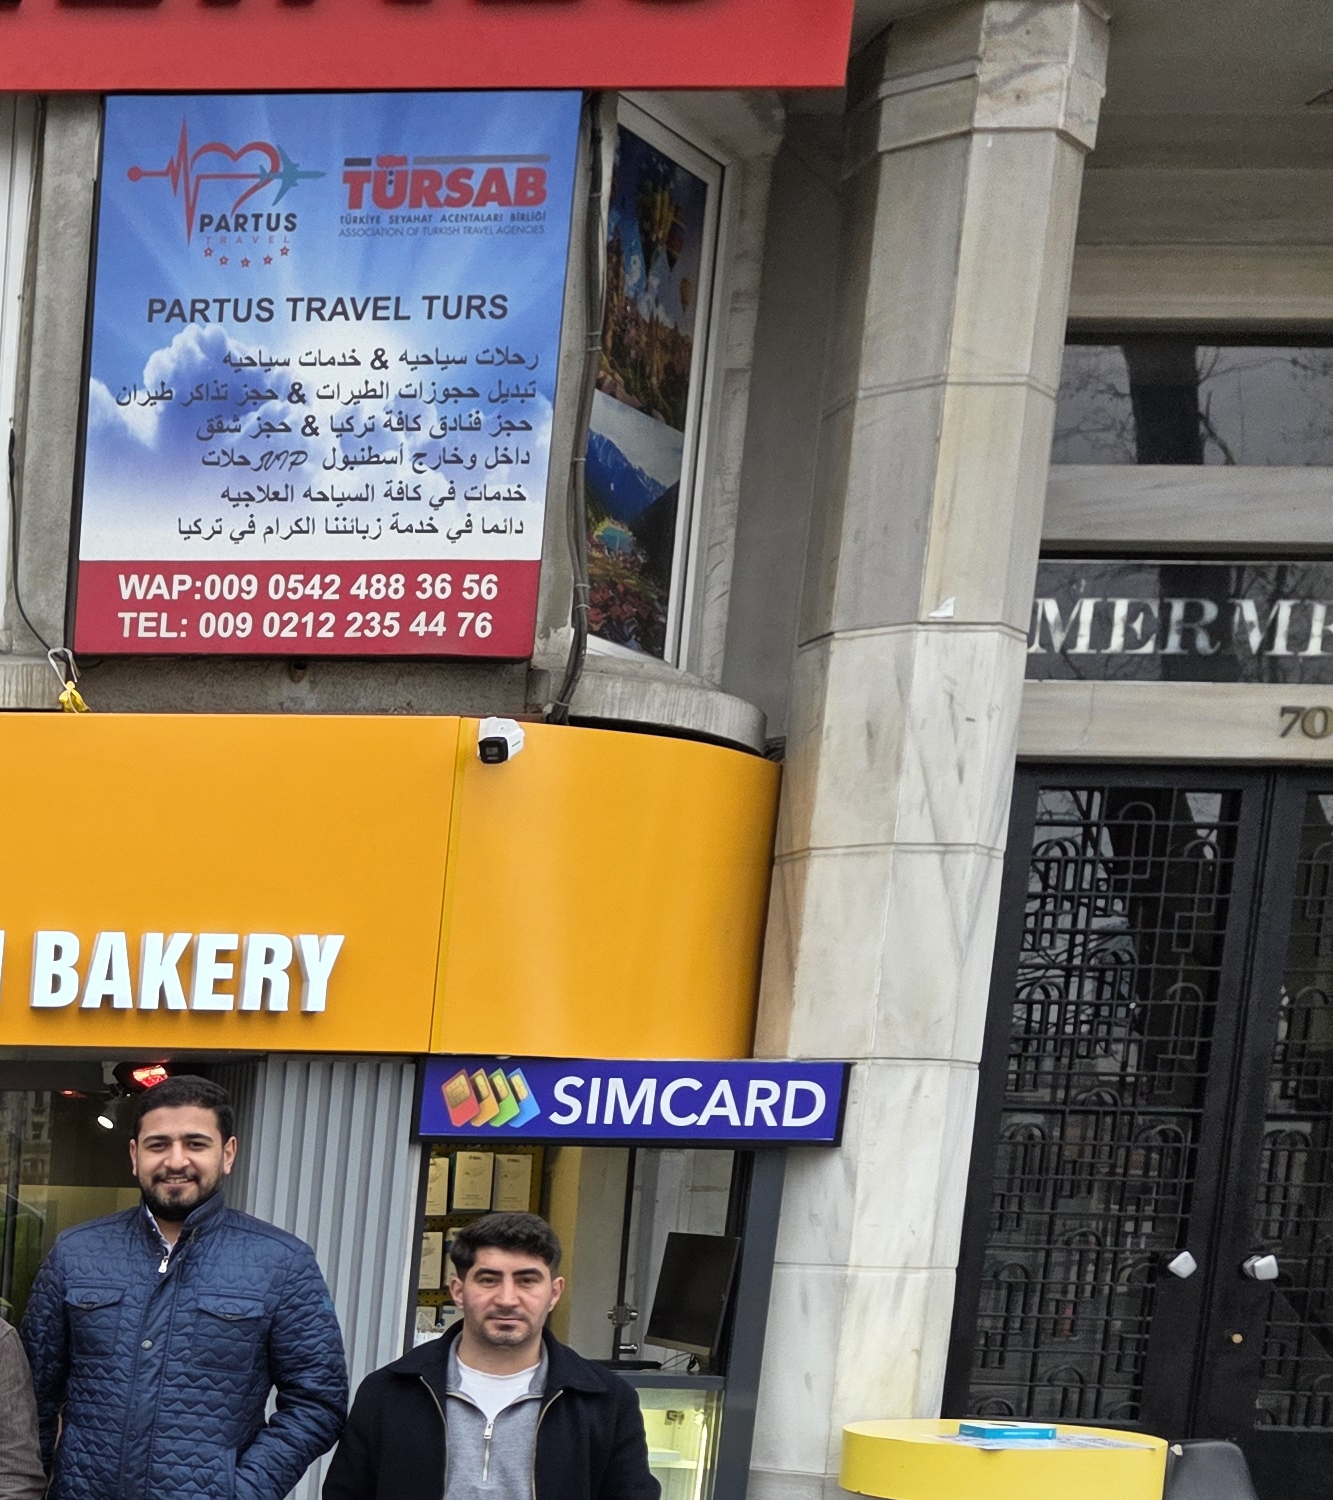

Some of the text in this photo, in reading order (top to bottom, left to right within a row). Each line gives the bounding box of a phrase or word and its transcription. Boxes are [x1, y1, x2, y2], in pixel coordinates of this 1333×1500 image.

[199, 212, 298, 234] PARTUS
[339, 213, 383, 226] TÜRKİYE
[388, 213, 433, 225] SEYAHAT
[440, 212, 504, 224] ACENTALARI
[206, 234, 291, 246] TRAVEL
[338, 224, 546, 238] ASSOCIATION OF TURKISH TRAVEL AGENCIES
[147, 294, 509, 324] PARTUS TRAVEL TURS
[298, 347, 361, 368] خدمات
[370, 347, 389, 370] &
[475, 346, 539, 370] رحلات
[115, 382, 174, 406] طيران
[240, 385, 279, 405] حجز
[286, 382, 306, 404] &
[403, 381, 480, 404] حجوزات
[249, 419, 292, 439] حجز
[300, 415, 320, 437] &
[429, 412, 482, 439] فنادق
[488, 417, 533, 438] حجز
[484, 445, 531, 468] داخل
[427, 482, 456, 511] في
[463, 481, 527, 502] خدمات
[230, 514, 256, 543] في
[263, 517, 315, 543] الكرام
[389, 512, 439, 536] خدمة
[446, 514, 473, 543] في
[268, 573, 340, 600] 0542
[350, 573, 406, 600] 488
[415, 573, 452, 600] 36
[461, 573, 498, 600] 56
[118, 610, 493, 638] TEL: 009 0212 235 44 76
[29, 930, 346, 1013] BAKERY
[548, 1075, 827, 1128] SIMCARD
